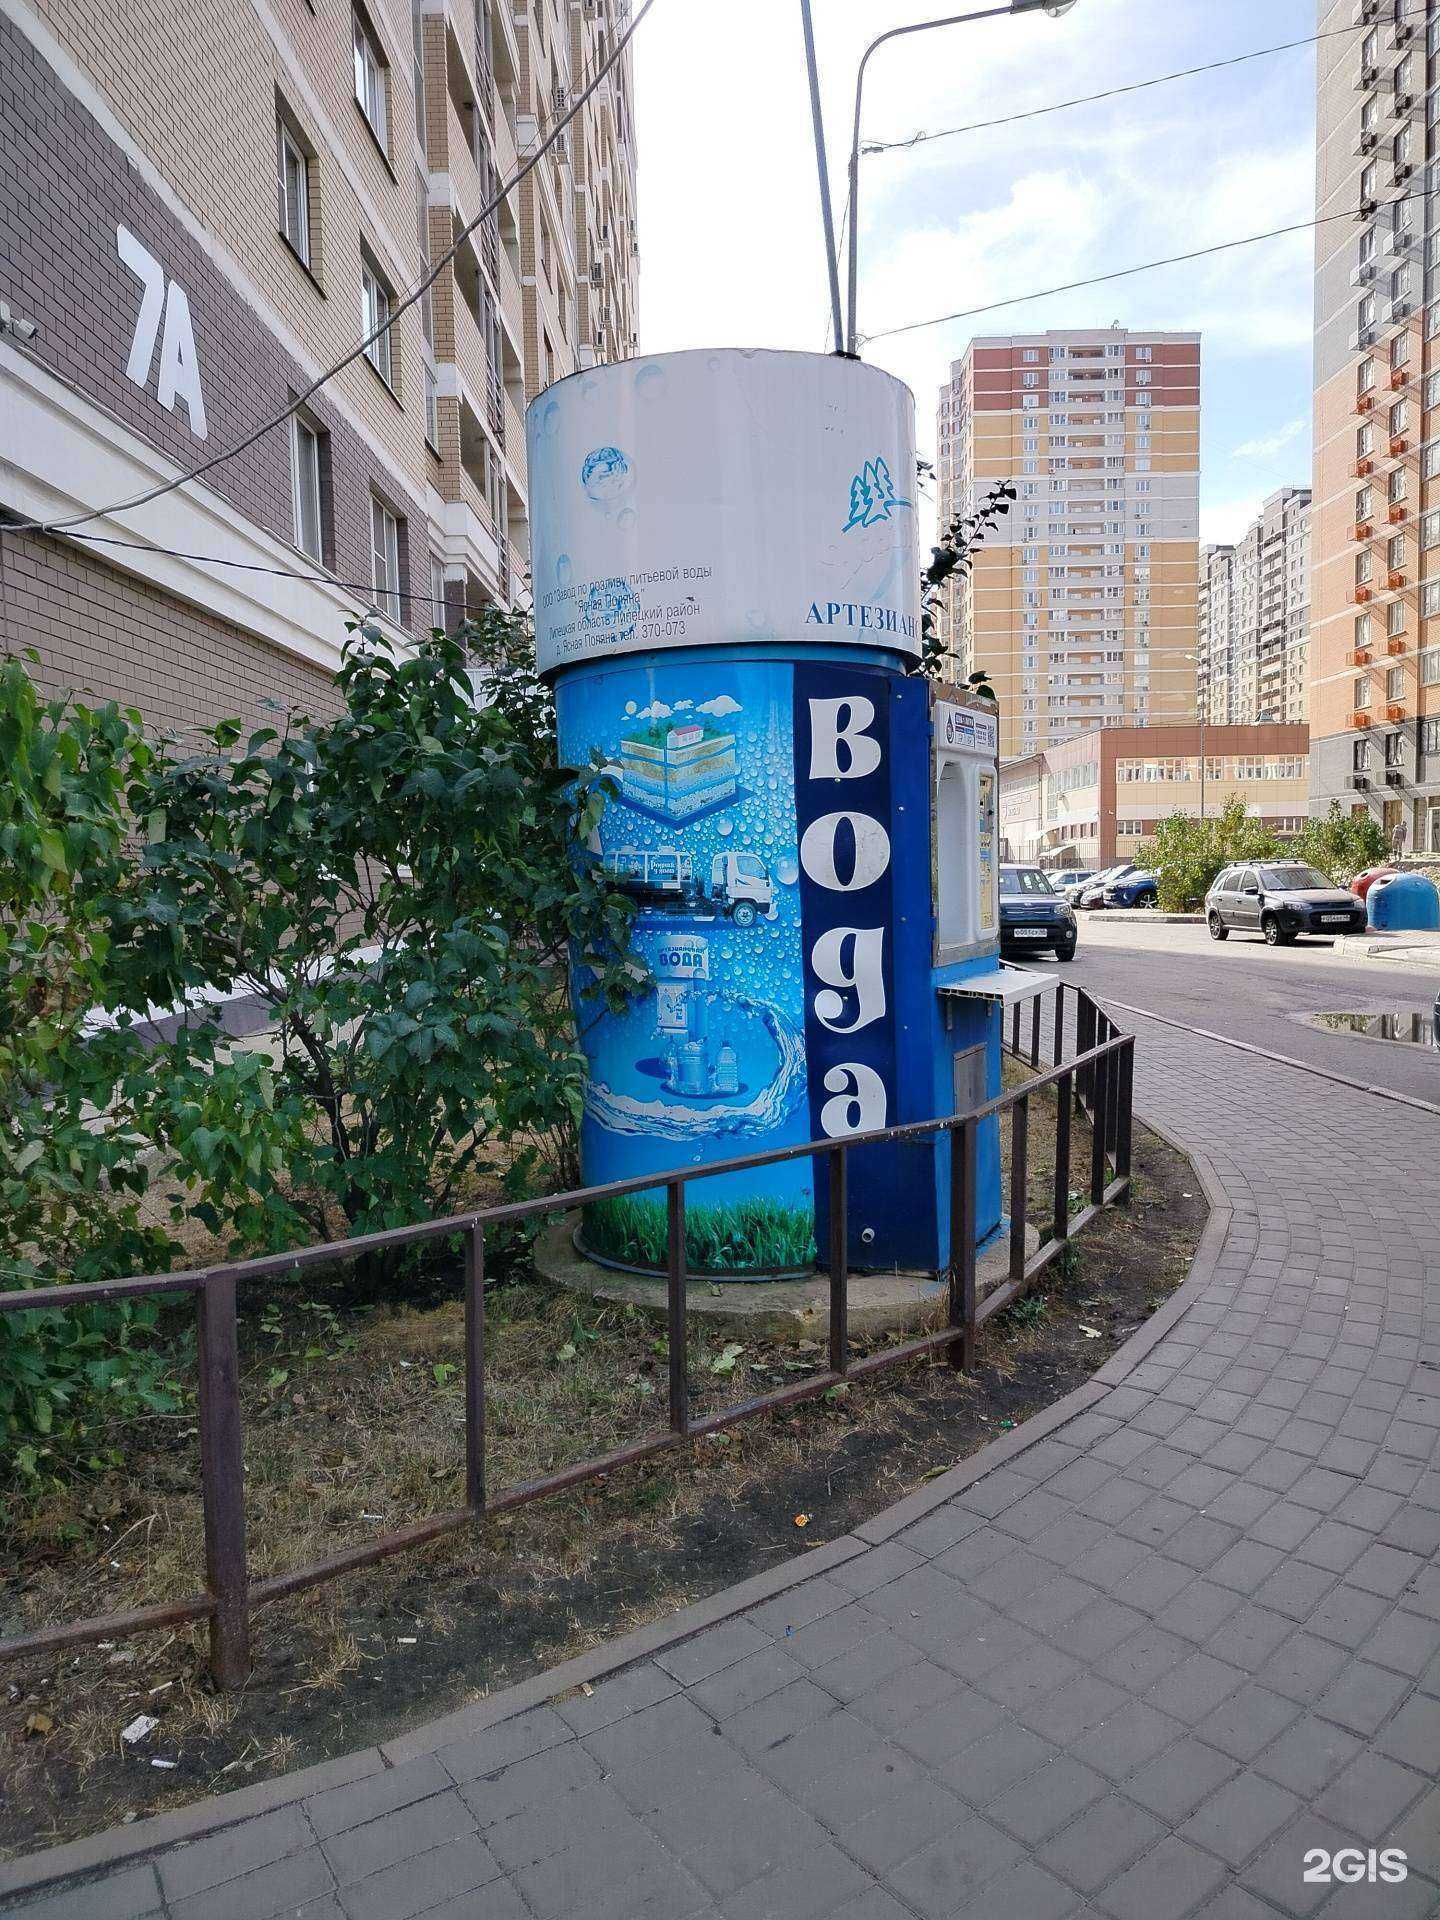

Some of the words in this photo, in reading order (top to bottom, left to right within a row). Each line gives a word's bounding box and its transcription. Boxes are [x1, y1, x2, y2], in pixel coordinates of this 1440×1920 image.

[578, 583, 588, 596] по
[629, 566, 679, 585] питьевой
[683, 567, 712, 580] воды
[578, 614, 611, 633] область
[613, 604, 663, 626] Липецкий
[666, 603, 701, 620] район
[562, 638, 583, 654] Ясная
[641, 620, 687, 639] 370-073
